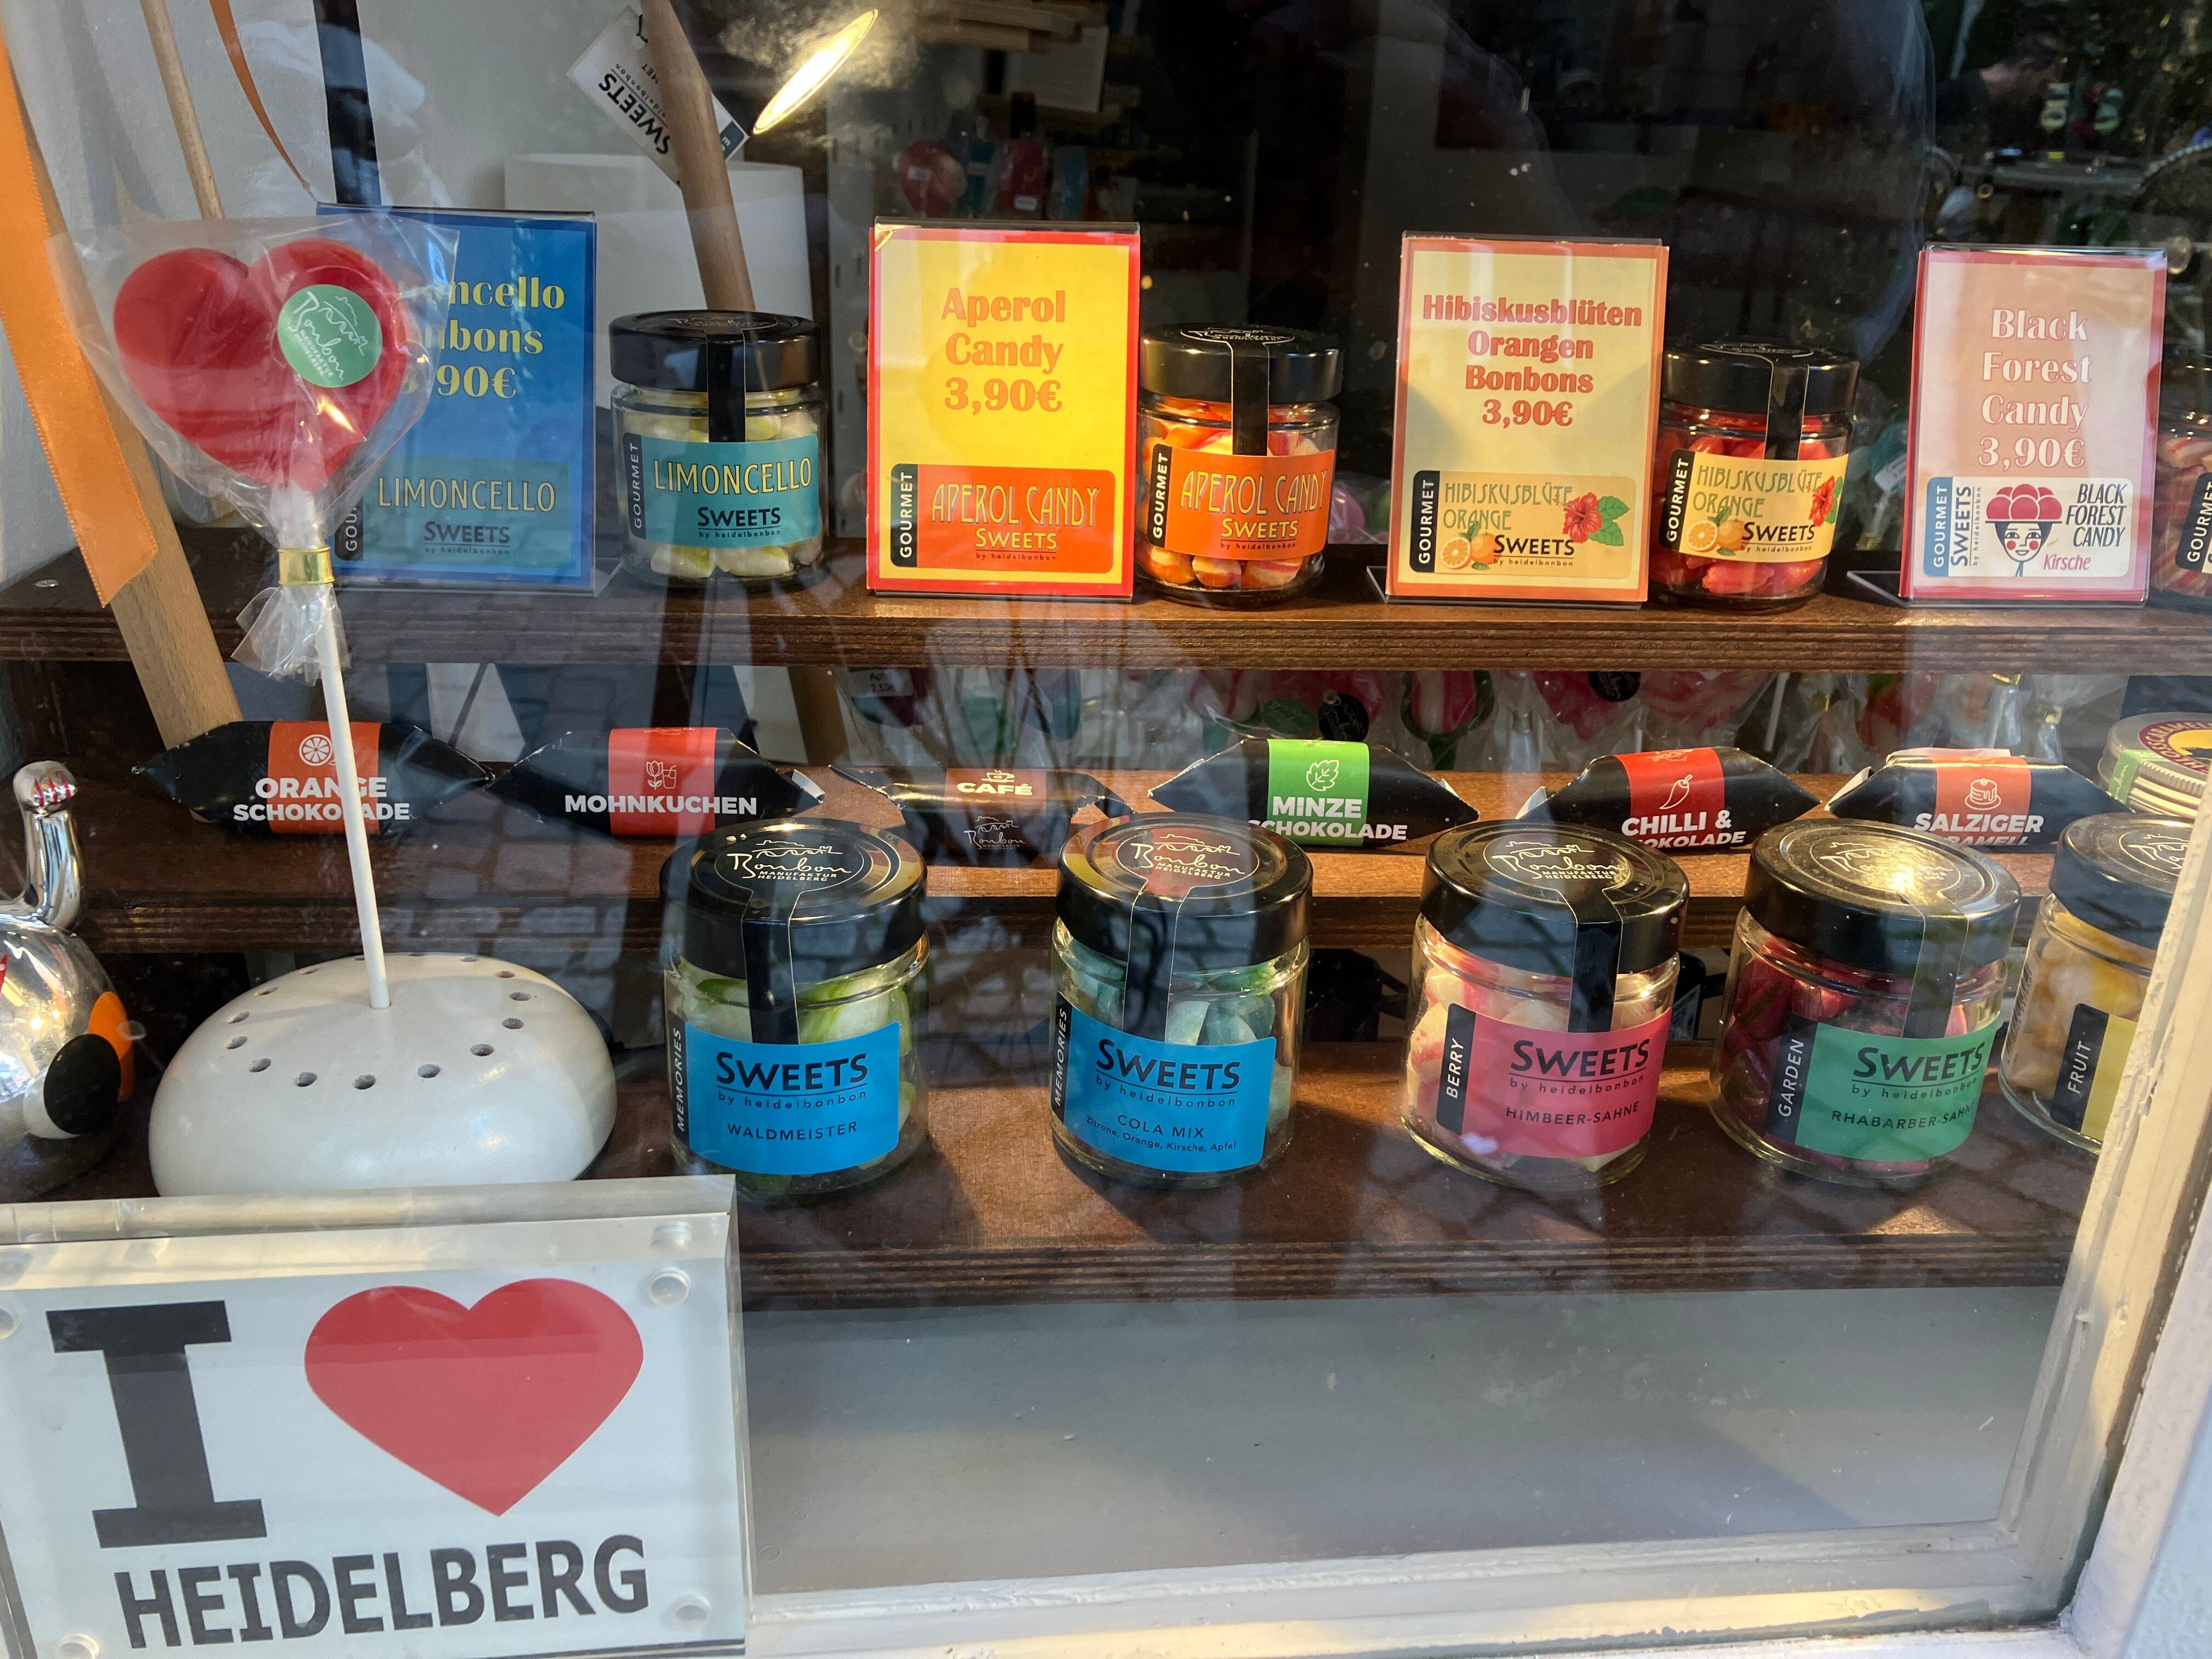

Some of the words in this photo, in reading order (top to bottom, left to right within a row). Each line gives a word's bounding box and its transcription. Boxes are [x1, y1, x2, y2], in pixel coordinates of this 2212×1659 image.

[599, 74, 670, 154] SWEETS
[941, 287, 1065, 328] Aperol
[1423, 295, 1642, 326] Hibiskusblüten
[1991, 308, 2087, 340] Black
[945, 332, 1064, 374] Candy
[1468, 330, 1593, 363] Orangen
[1465, 365, 1593, 393] Bonbons
[1982, 352, 2092, 383] Forest
[944, 377, 1063, 415] 3,90€
[1482, 400, 1573, 429] 3,90€
[1981, 394, 2089, 432] Candy
[1977, 437, 2085, 471] 3,90€
[629, 442, 641, 529] GOURMET
[653, 457, 812, 495] LIMONCELLO
[1696, 465, 1823, 494] HIBISKUSBLÜTE
[377, 476, 556, 513] LIMONCELLO
[931, 482, 1020, 526] APEROL
[1026, 485, 1100, 528] CANDY
[1153, 453, 1169, 539] GOURMET
[1180, 470, 1267, 515] APEROL
[1274, 469, 1328, 515] CANDY
[1444, 482, 1573, 506] HIBISKUSBLÜTE
[1666, 458, 1689, 542] GOURMET
[1693, 492, 1765, 518] ORANGE
[2077, 483, 2128, 504] BLACK
[697, 506, 781, 527] SWEETS
[900, 472, 913, 558] GOURMET
[1220, 517, 1299, 539] SWEETS
[1418, 479, 1435, 564] GOURMET
[1443, 509, 1512, 531] ORANGE
[1933, 486, 1948, 568] GOURMET
[1950, 486, 1972, 567] SWEETS
[2066, 505, 2127, 526] FOREST
[424, 521, 510, 544] SWEETS
[698, 531, 709, 539] by
[715, 529, 781, 538] heidelbonbon
[975, 528, 1058, 550] SWEETS
[1220, 541, 1231, 550] by
[1235, 541, 1296, 550] heidelbonbon
[1493, 534, 1575, 556] SWEETS
[1741, 522, 1816, 542] SWEETS
[2073, 527, 2126, 548] CANDY
[975, 552, 986, 561] by
[991, 552, 1057, 561] heidelbonbon
[1508, 558, 1573, 567] heidelbonbon
[1740, 544, 1751, 553] by
[2042, 554, 2092, 571] Kirsche
[956, 782, 1033, 796] CAFÉ
[233, 803, 410, 822] SCHOKOADE
[565, 795, 757, 815] MOHNKUCHEN
[1272, 796, 1363, 819] MINZE
[1621, 811, 1707, 836] CHILLI
[1715, 810, 1732, 829] &
[1914, 812, 2045, 833] SALZIGER
[726, 853, 852, 879] Bonbon
[1130, 843, 1245, 874] Bonbon
[1155, 866, 1221, 879] HEIDELBERG
[1156, 862, 1231, 877] MANUFAKTUR
[1491, 855, 1625, 879] Bonbon
[716, 1051, 868, 1091] SWEETS
[1054, 1008, 1067, 1108] MEMORIES
[1096, 1039, 1240, 1090] SWEETS
[1446, 1037, 1464, 1099] BERRY
[1510, 1039, 1651, 1077] SWEETS
[1853, 1041, 1985, 1082] SWEETS
[2067, 1040, 2091, 1094] FRUIT
[673, 1026, 686, 1133] MEMORIES
[1096, 1074, 1111, 1091] by
[1120, 1085, 1236, 1107] heidelbonbon
[1509, 1077, 1528, 1091] by
[1538, 1074, 1645, 1095] heidelbonbon
[1778, 1038, 1804, 1118] GARDEN
[1852, 1084, 1871, 1098] by
[718, 1090, 735, 1106] by
[744, 1090, 866, 1109] heidelbonbon
[1505, 1101, 1640, 1125] HIMBEER-SAHNE
[727, 1121, 858, 1141] WALDMEISTER
[1086, 1114, 1120, 1139] Zitrone,
[1122, 1132, 1163, 1149] Orange,
[1166, 1142, 1206, 1153] Kirsche,
[1210, 1141, 1237, 1153] Apfel
[1117, 1114, 1164, 1136] COLA
[1172, 1126, 1205, 1138] MIX
[46, 1300, 268, 1549] I
[114, 1534, 650, 1649] HEIDELBERG
